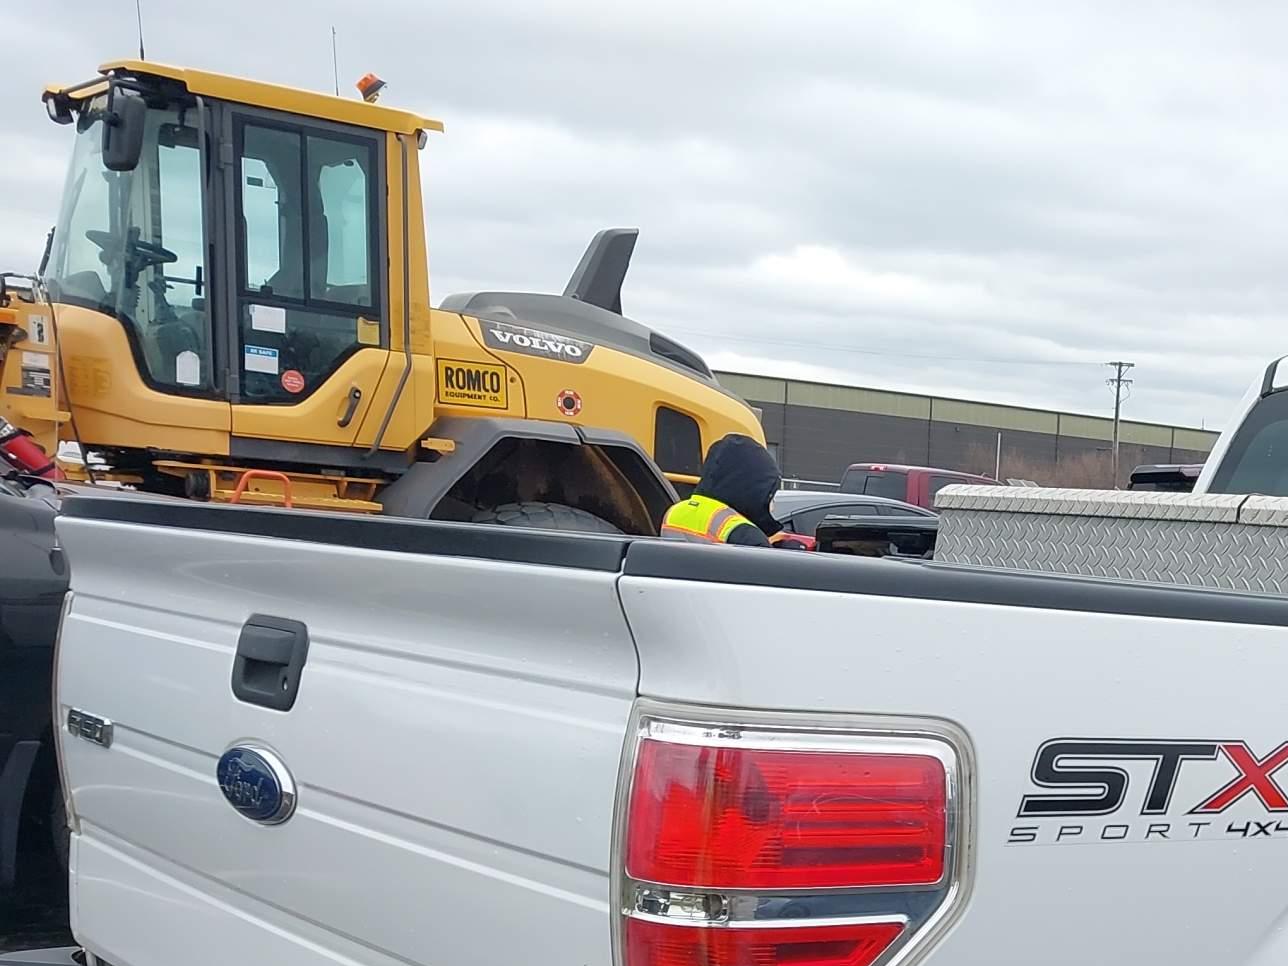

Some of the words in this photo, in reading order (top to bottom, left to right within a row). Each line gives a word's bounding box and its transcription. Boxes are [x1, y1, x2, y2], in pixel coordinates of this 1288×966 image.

[490, 329, 582, 357] VOLVO
[445, 367, 500, 393] ROMCO
[445, 391, 487, 401] EQUIPMENT
[1007, 822, 1212, 842] SPORT
